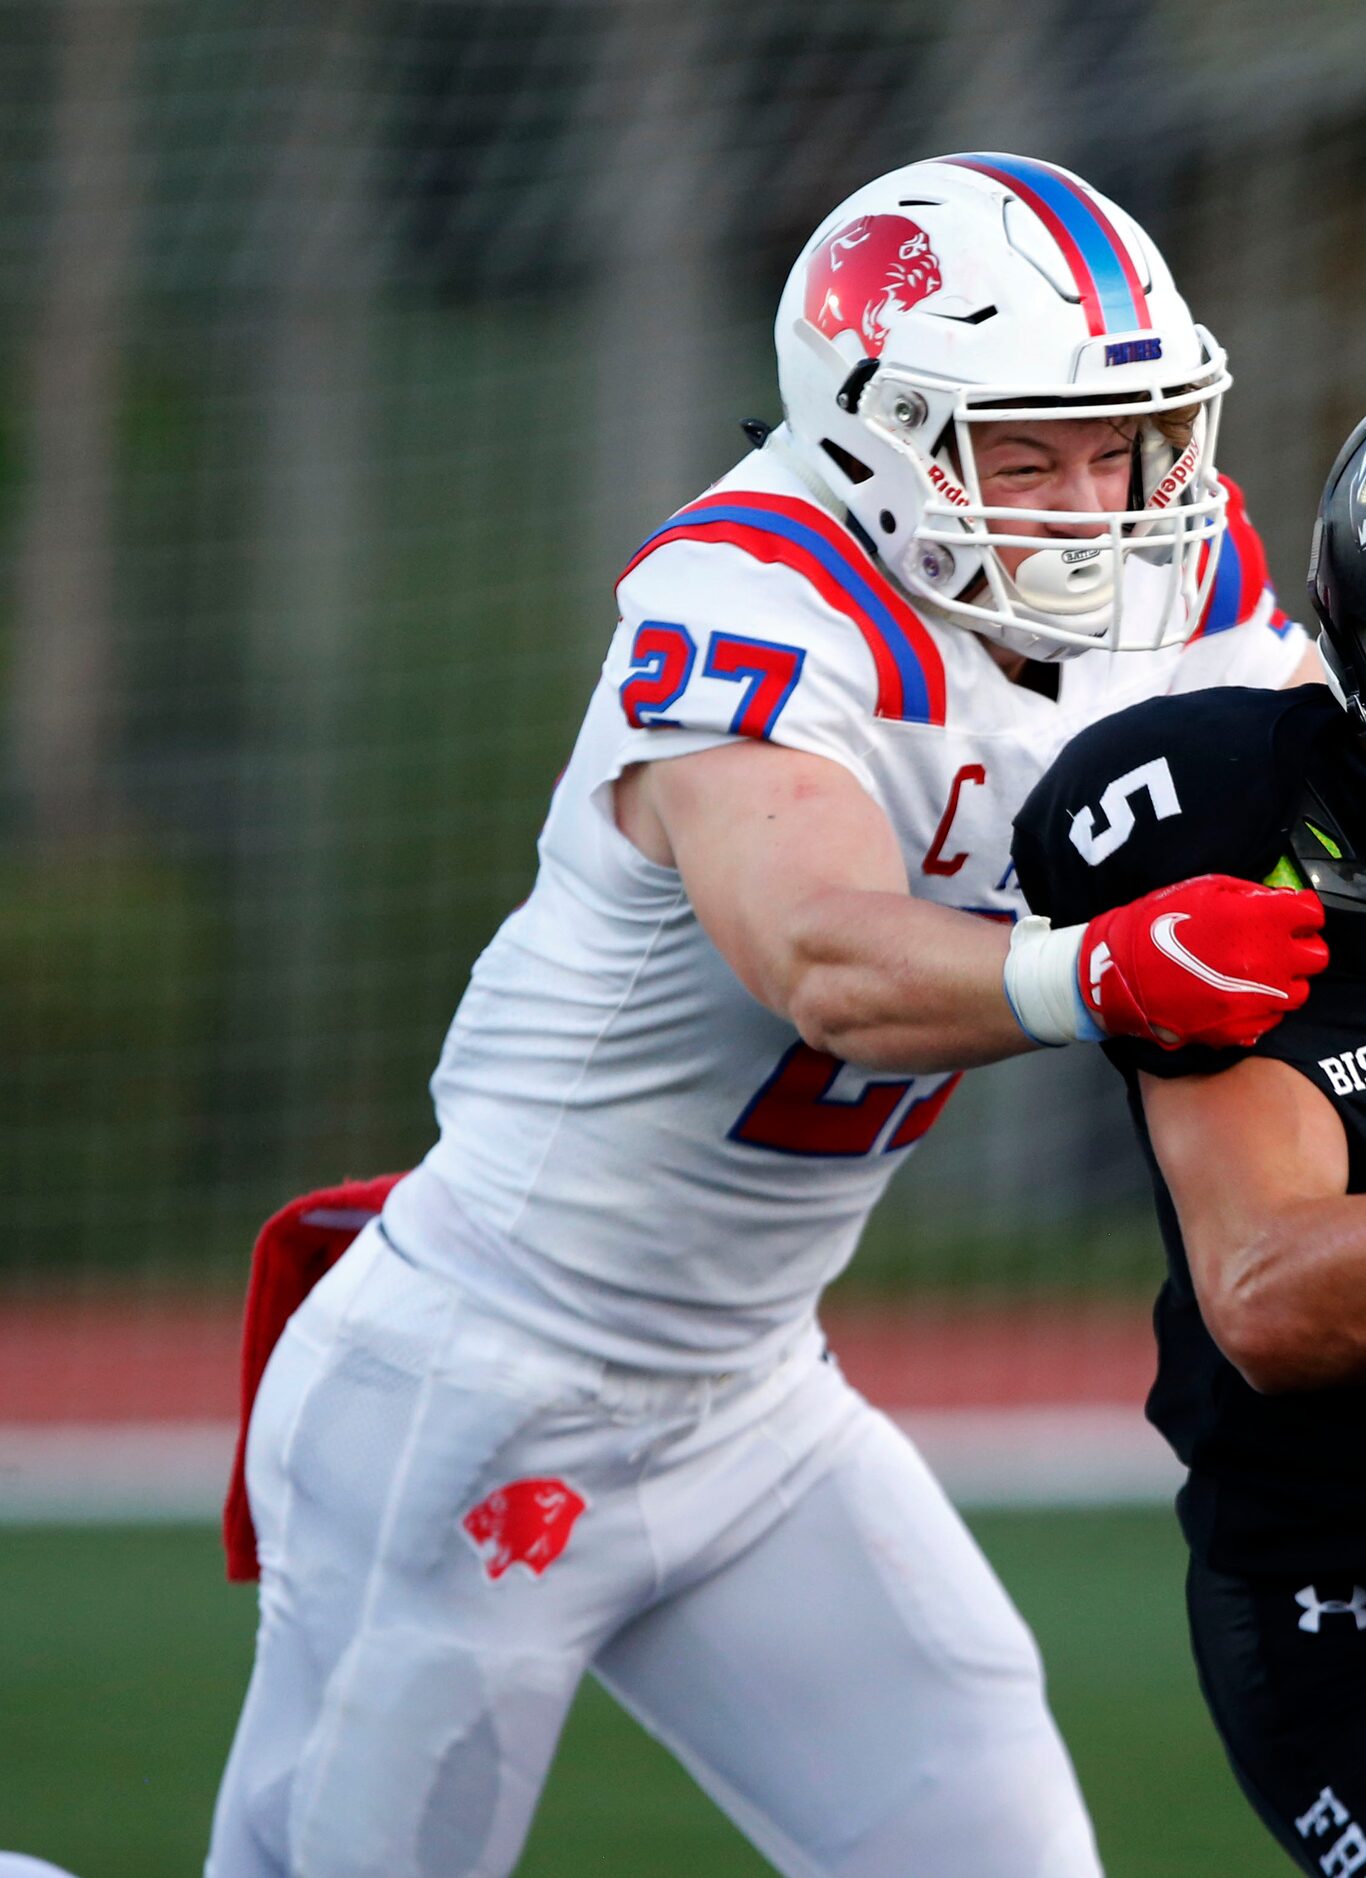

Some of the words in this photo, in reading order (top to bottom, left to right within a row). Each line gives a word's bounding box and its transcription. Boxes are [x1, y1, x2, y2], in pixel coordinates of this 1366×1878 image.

[619, 620, 806, 740] 27
[922, 763, 986, 876] C
[1068, 757, 1182, 867] 5
